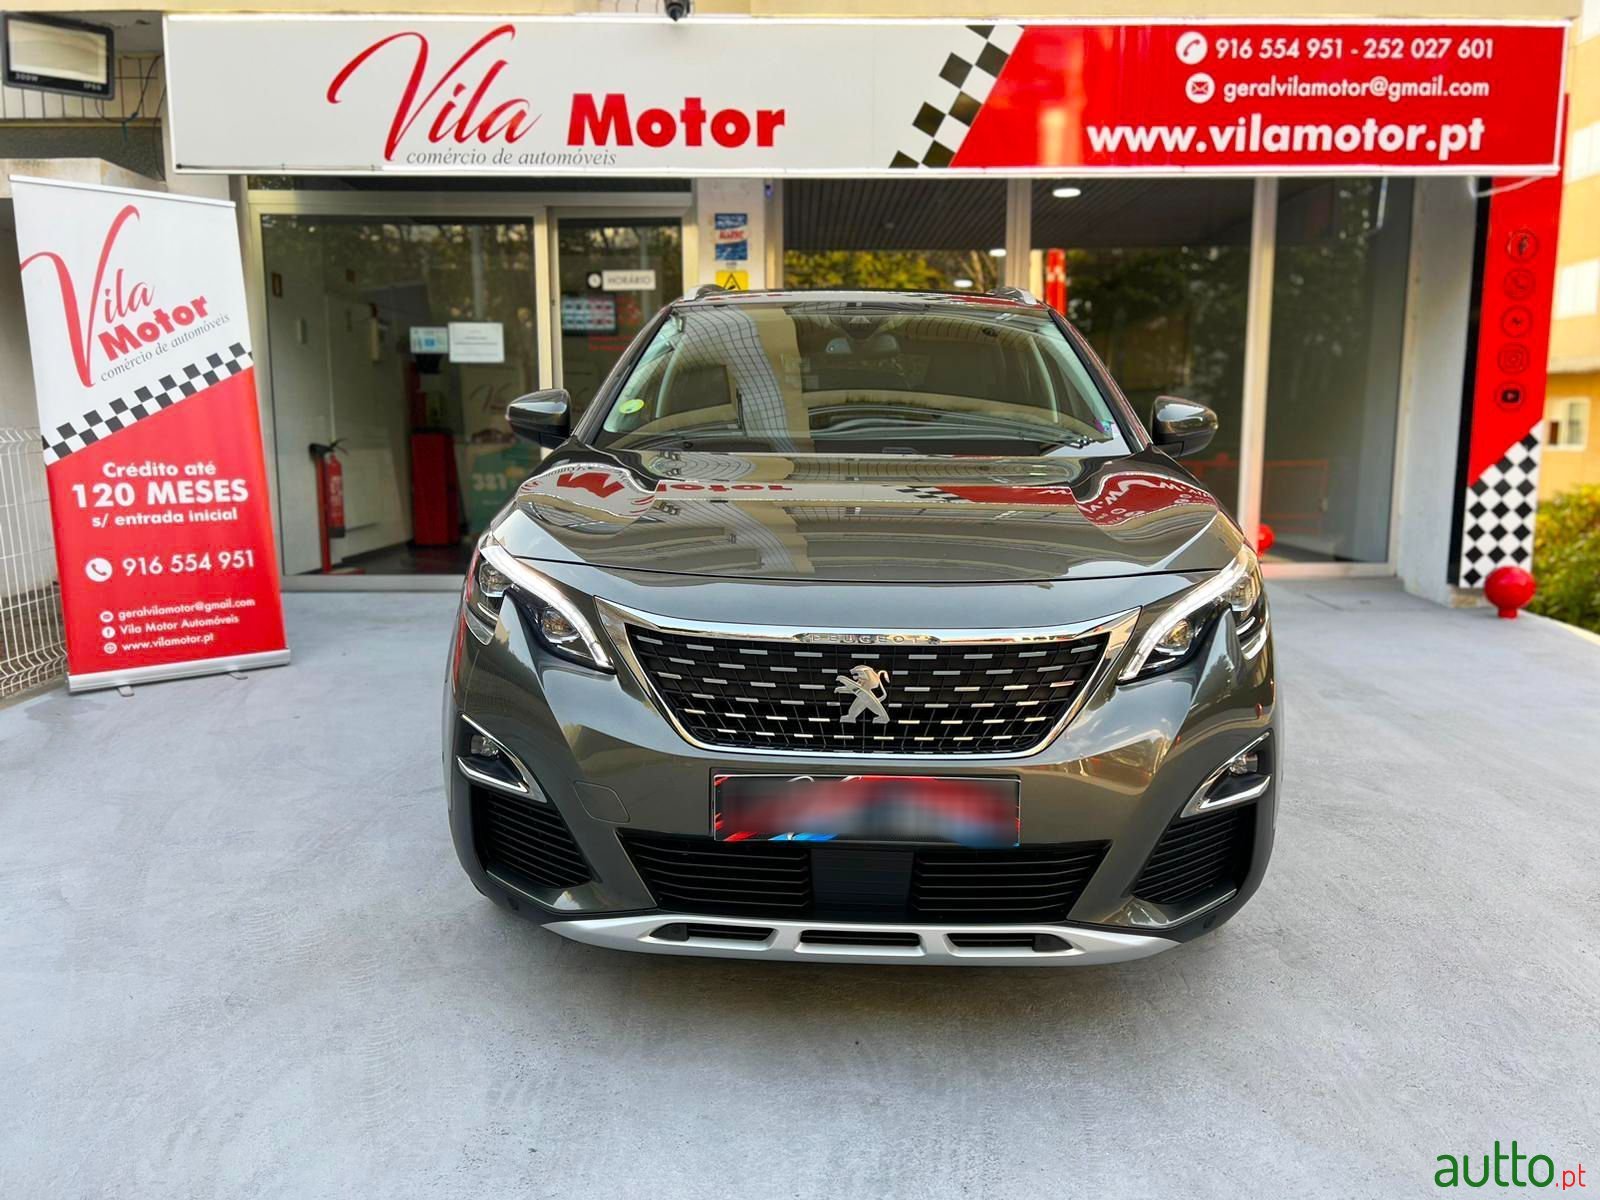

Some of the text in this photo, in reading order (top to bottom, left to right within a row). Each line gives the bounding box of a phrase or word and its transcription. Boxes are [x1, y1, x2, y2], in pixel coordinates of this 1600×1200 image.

[1215, 38, 1253, 59] 916
[1259, 38, 1300, 59] 554
[1306, 38, 1344, 59] 951
[1363, 38, 1404, 59] 252
[1411, 38, 1450, 59] 027
[1457, 38, 1494, 59] 601
[327, 24, 542, 161] Vila
[1223, 75, 1490, 102] geralvilamotor@gmail.com
[567, 93, 785, 148] Motor
[1087, 113, 1485, 161] www.vilamotor.pt
[406, 147, 617, 166] comércio de automóveis
[20, 204, 155, 388] Vila
[97, 295, 208, 361] Motor
[100, 312, 231, 382] comércio de automóveis
[102, 461, 217, 478] Crédito até
[72, 479, 249, 508] 120 MESES
[92, 507, 238, 528] s/ entrada inicial
[122, 549, 254, 577] 916 554 951
[118, 597, 256, 622] geralvilamotor@gmail.com
[119, 613, 240, 635] Vila Motor Automóveis
[811, 634, 921, 643] PEUGEOT
